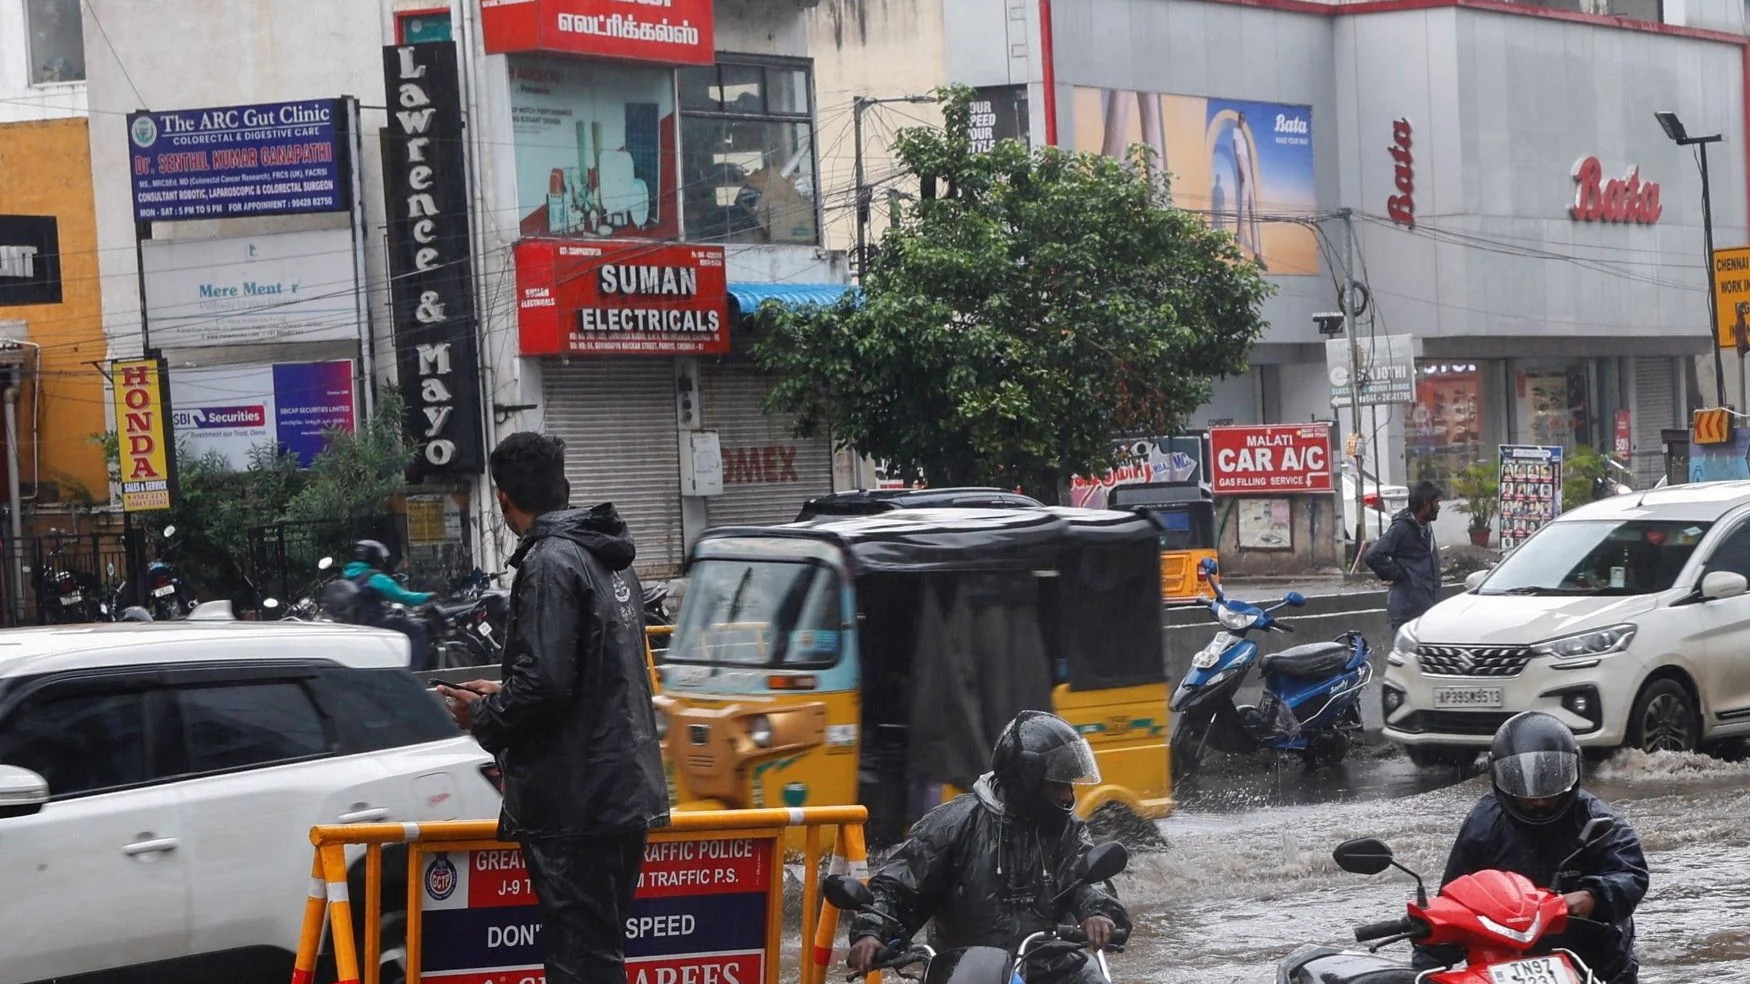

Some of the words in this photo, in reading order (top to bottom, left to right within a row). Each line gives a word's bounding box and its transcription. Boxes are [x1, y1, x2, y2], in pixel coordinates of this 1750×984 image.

[161, 115, 194, 133] The
[200, 111, 238, 129] ARC
[244, 109, 273, 126] Gut
[280, 105, 329, 124] Clinic
[970, 113, 996, 127] PEED
[1274, 114, 1308, 134] Bata
[173, 130, 234, 145] COLORECTAL
[236, 130, 242, 141] &
[245, 128, 292, 141] DIGESTIVE
[295, 126, 320, 137] CARE
[968, 127, 992, 140] OUR
[158, 151, 209, 173] SENTHIL
[213, 147, 258, 169] KUMAR
[260, 143, 332, 166] GANAPATHI
[396, 46, 440, 271] Lawrence
[1387, 117, 1415, 230] Bata
[138, 190, 177, 202] CONSULTANT
[179, 188, 208, 200] ROBOTIC,
[209, 185, 255, 198] LAPAROSCOPIC
[262, 182, 302, 194] COLORECTAL
[303, 180, 334, 191] SURGEON
[1571, 156, 1663, 224] Bata
[140, 208, 155, 217] MON
[161, 207, 173, 216] SAT
[229, 203, 242, 211] FOR
[1717, 256, 1749, 272] CHENNAI
[199, 283, 238, 298] Mere
[601, 264, 697, 296] SUMAN
[1720, 280, 1742, 293] WORK
[525, 288, 550, 298] SUMAN
[416, 290, 447, 324] &
[582, 308, 720, 332] ELECTRICALS
[416, 343, 456, 466] Mayo
[121, 366, 158, 478] HONDA
[173, 414, 190, 426] SBI
[209, 411, 260, 423] Securities
[1247, 435, 1293, 446] MALATI
[1218, 447, 1273, 472] CAR
[1281, 446, 1324, 471] A/C
[145, 480, 167, 490] SERVICE
[1219, 478, 1235, 487] GAS
[1237, 477, 1266, 486] FILLING
[1270, 476, 1303, 485] SERVICE
[643, 842, 694, 862] RAFFIC
[700, 840, 753, 860] POLICE
[433, 874, 450, 889] GCTP
[498, 879, 520, 895] J-9
[649, 869, 710, 887] TRAFFIC
[715, 868, 739, 884] P.S.
[625, 914, 696, 939] SPEED
